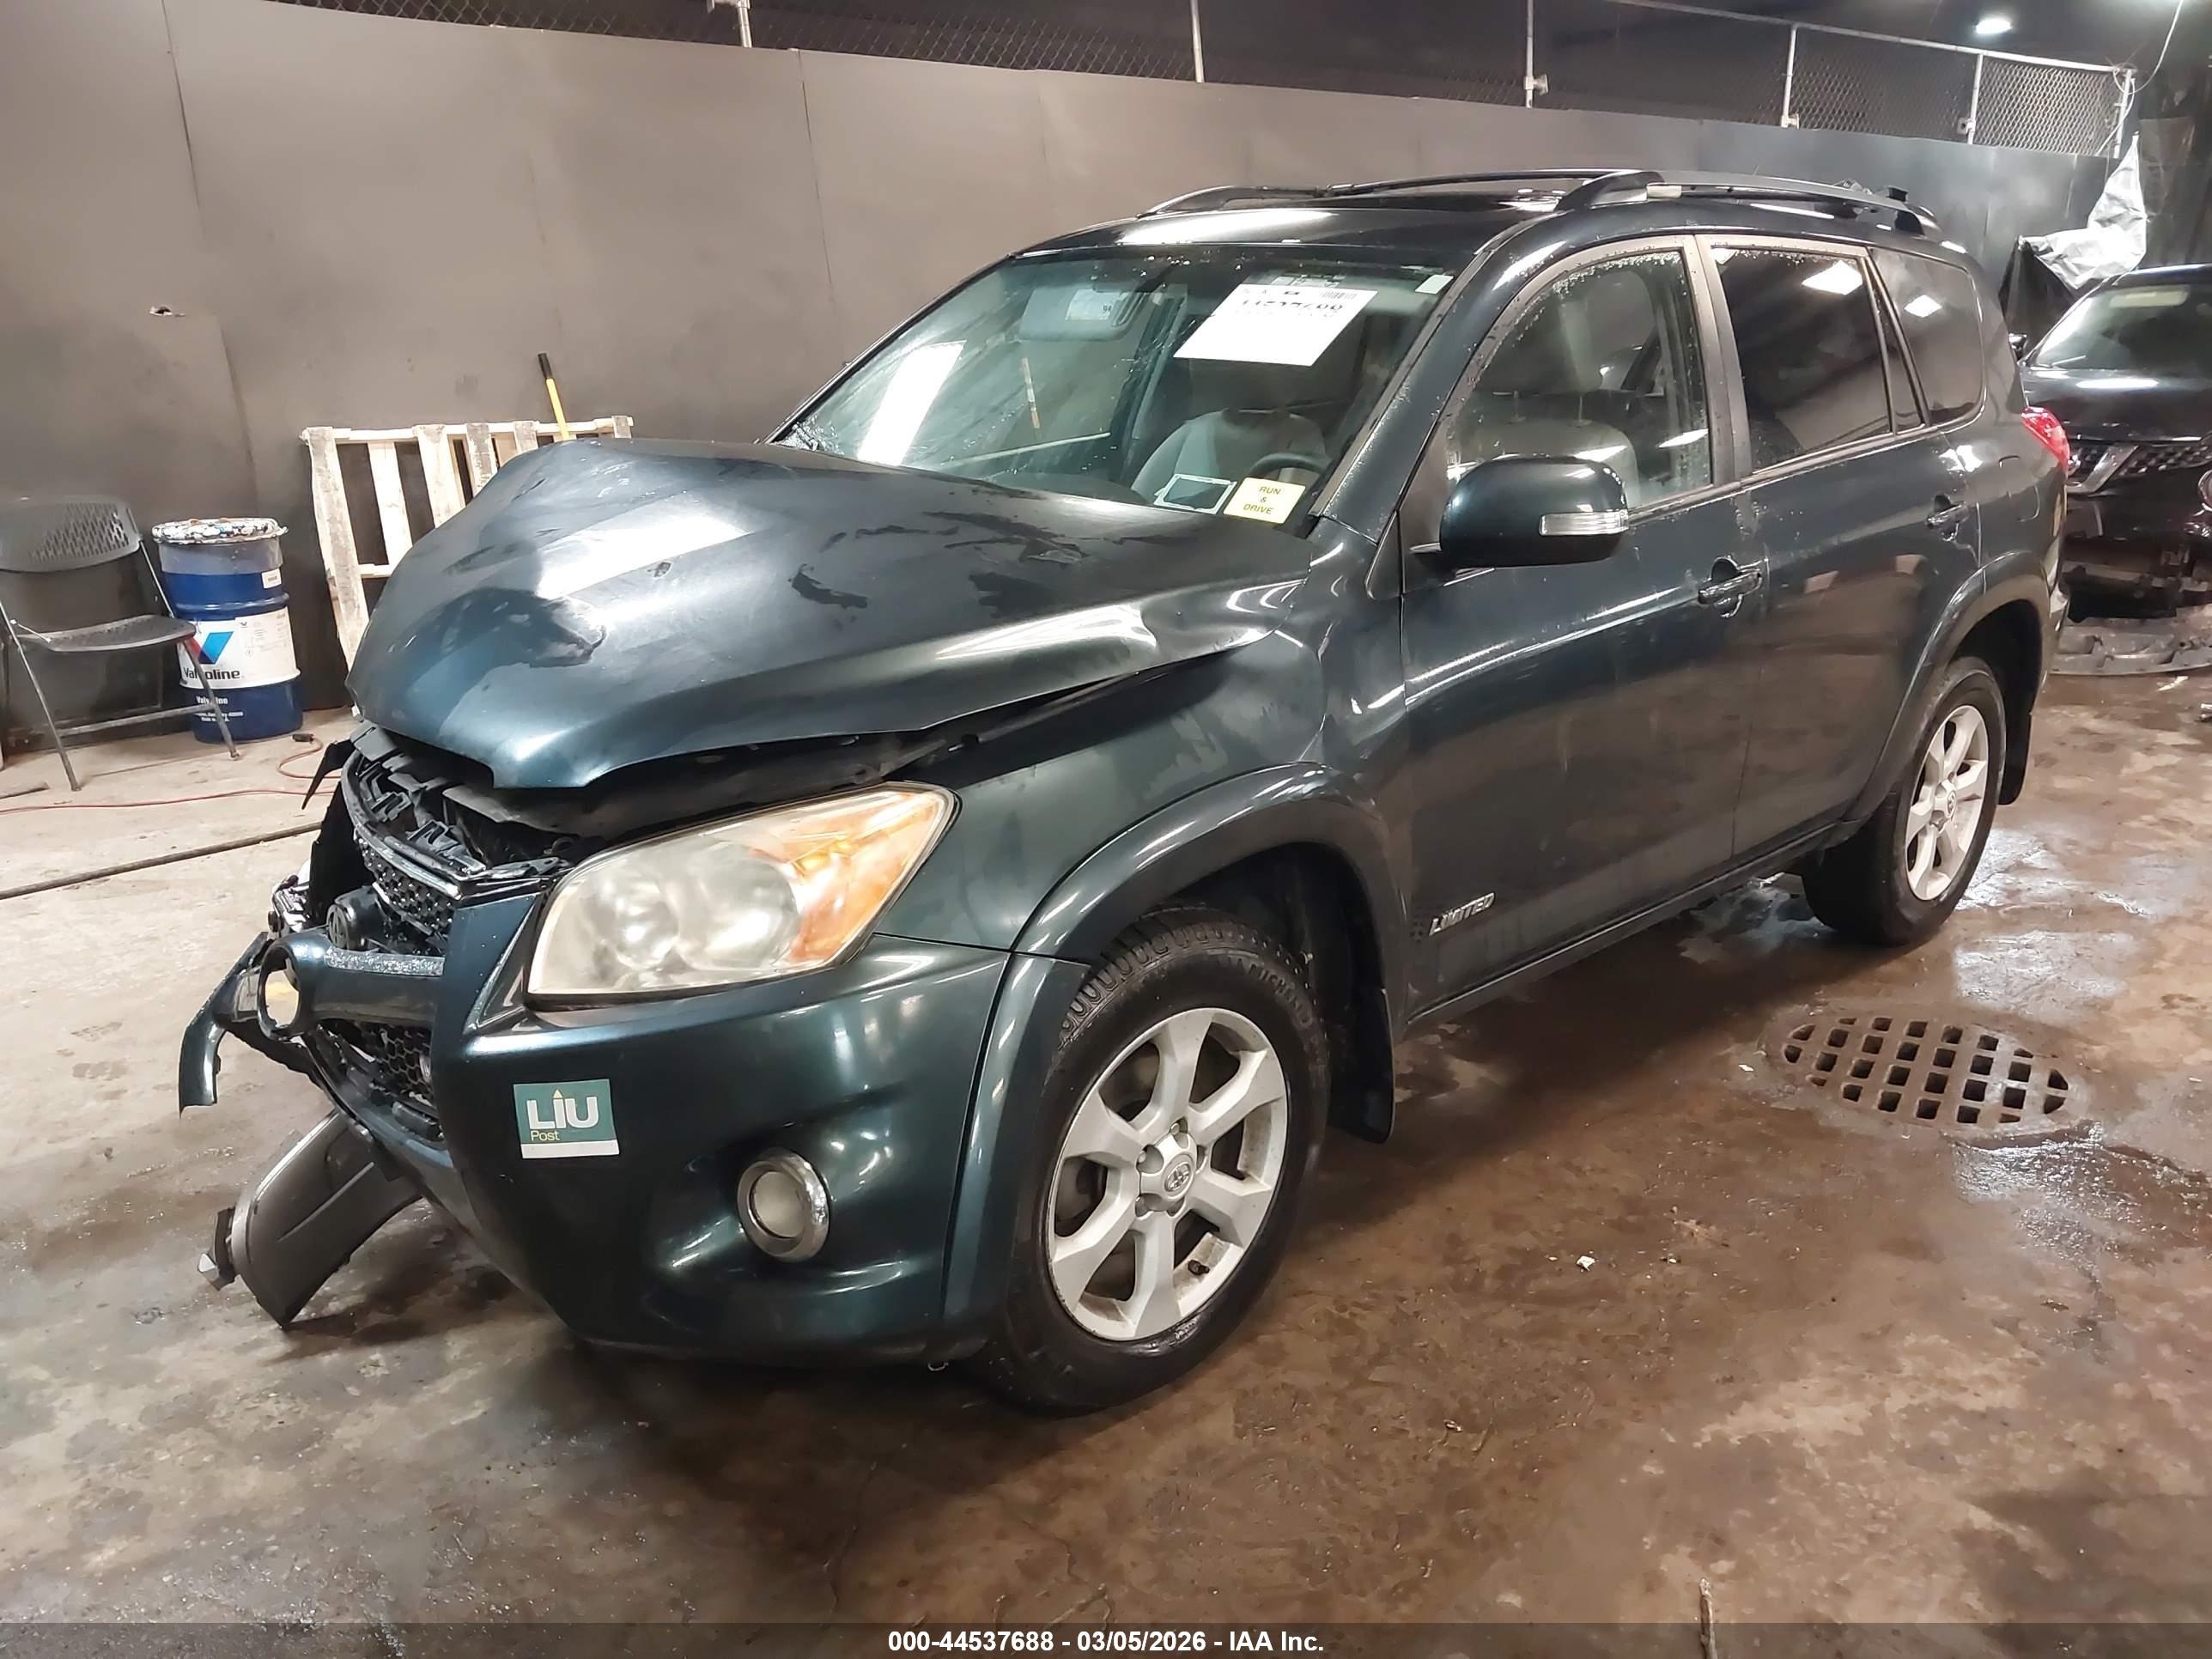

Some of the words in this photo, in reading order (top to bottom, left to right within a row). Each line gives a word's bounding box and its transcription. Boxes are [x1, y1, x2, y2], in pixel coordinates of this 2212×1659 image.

[1258, 485, 1282, 495] RUN
[1243, 503, 1274, 514] DRIVE
[183, 666, 240, 680] Valoline
[196, 696, 228, 705] Valvine
[530, 1130, 561, 1141] Post
